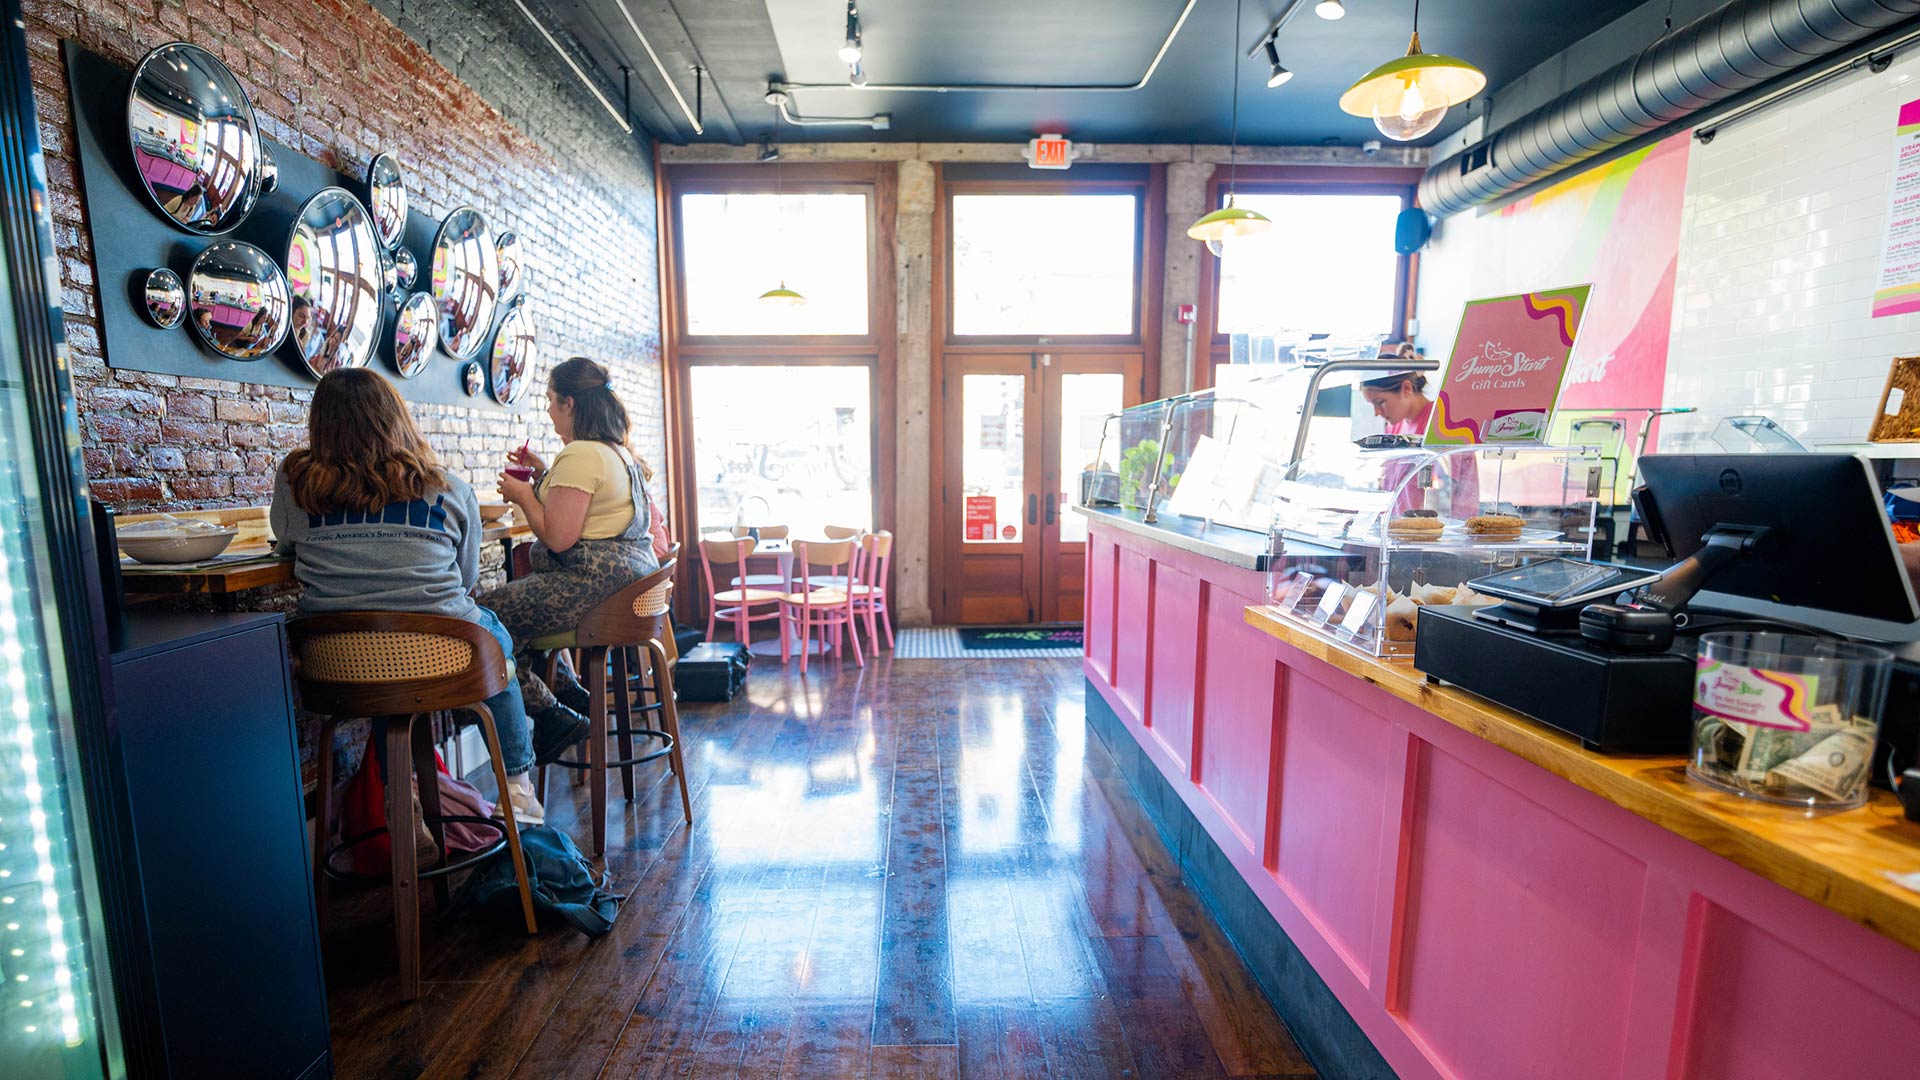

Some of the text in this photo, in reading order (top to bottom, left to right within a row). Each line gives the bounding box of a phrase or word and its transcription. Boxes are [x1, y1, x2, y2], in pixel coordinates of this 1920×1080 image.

[1036, 140, 1068, 165] EXIT
[1456, 352, 1554, 382] Jump Start
[1471, 378, 1526, 390] Gift Cards
[335, 531, 375, 539] AMERICA'S
